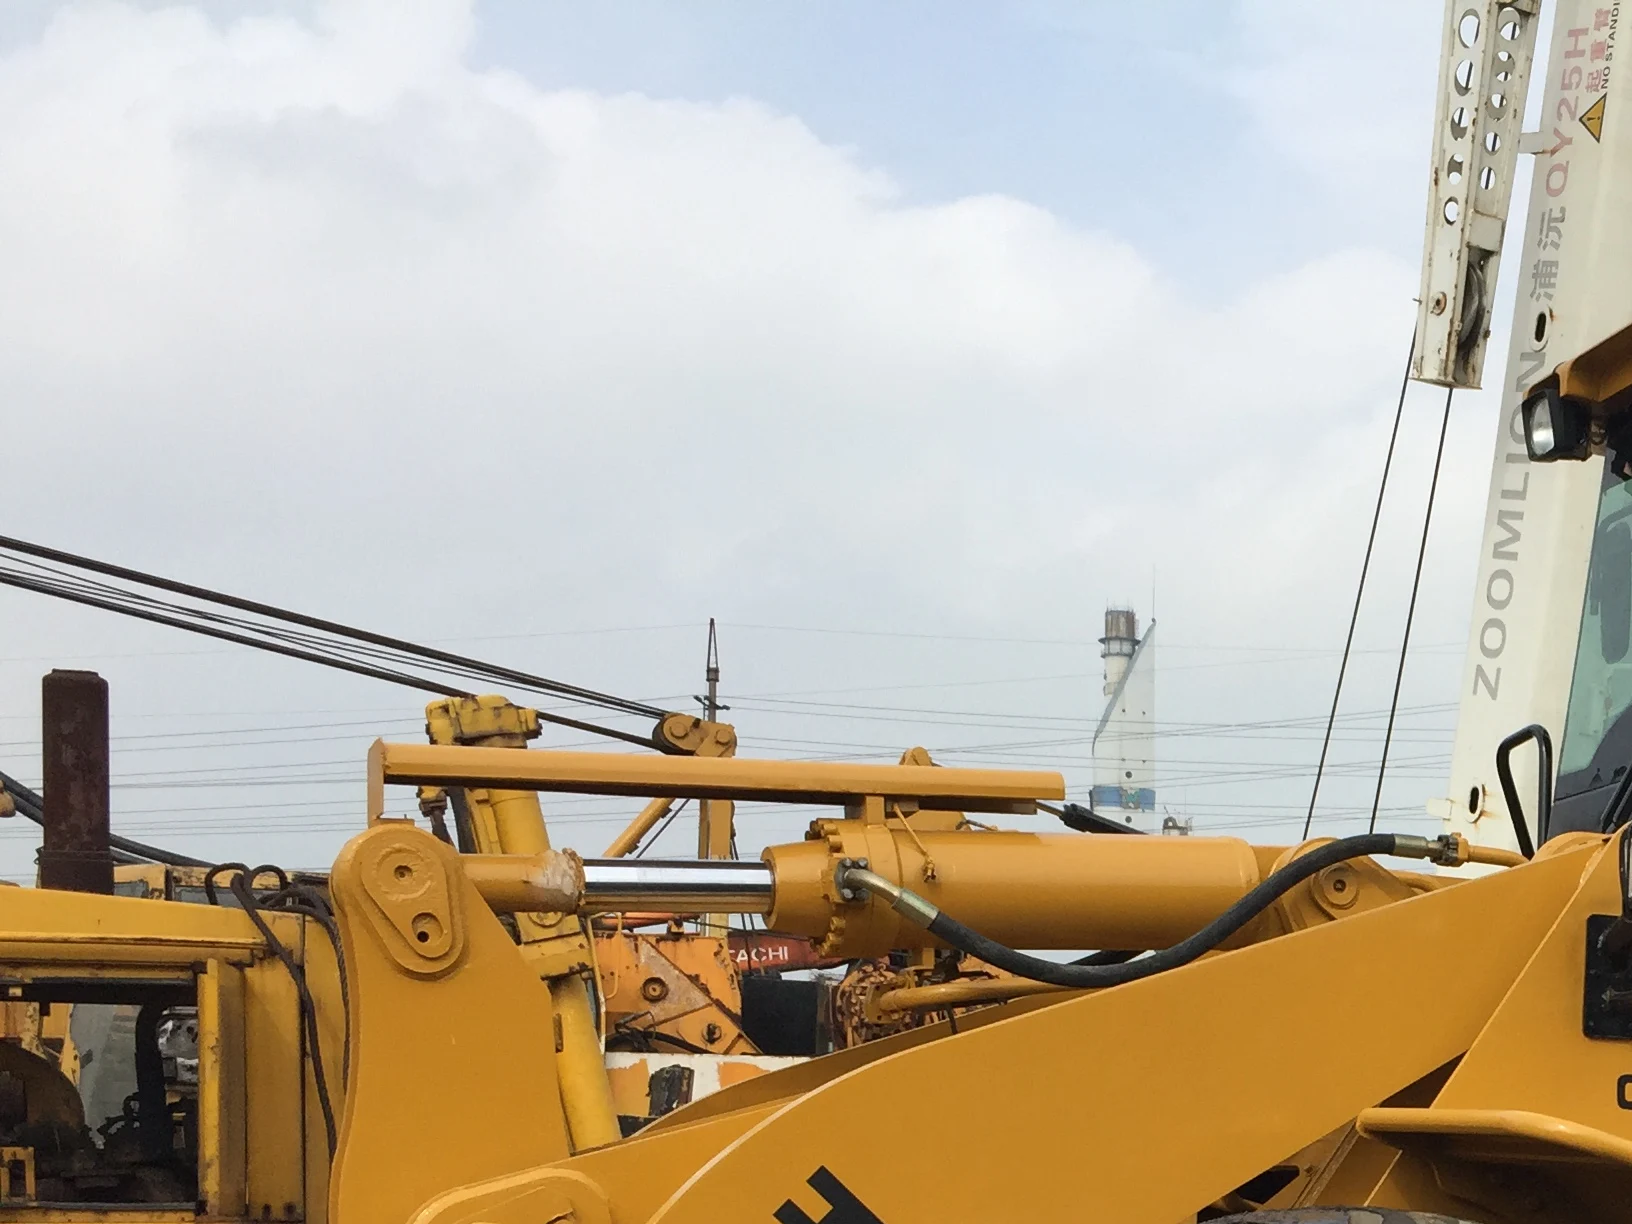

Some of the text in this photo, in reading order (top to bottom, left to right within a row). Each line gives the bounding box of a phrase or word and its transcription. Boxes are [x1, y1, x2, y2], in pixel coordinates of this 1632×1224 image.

[1600, 0, 1621, 89] NO STANDI
[1545, 27, 1589, 197] QY25H
[1530, 205, 1567, 302] 浦沅
[729, 946, 789, 963] ACHI
